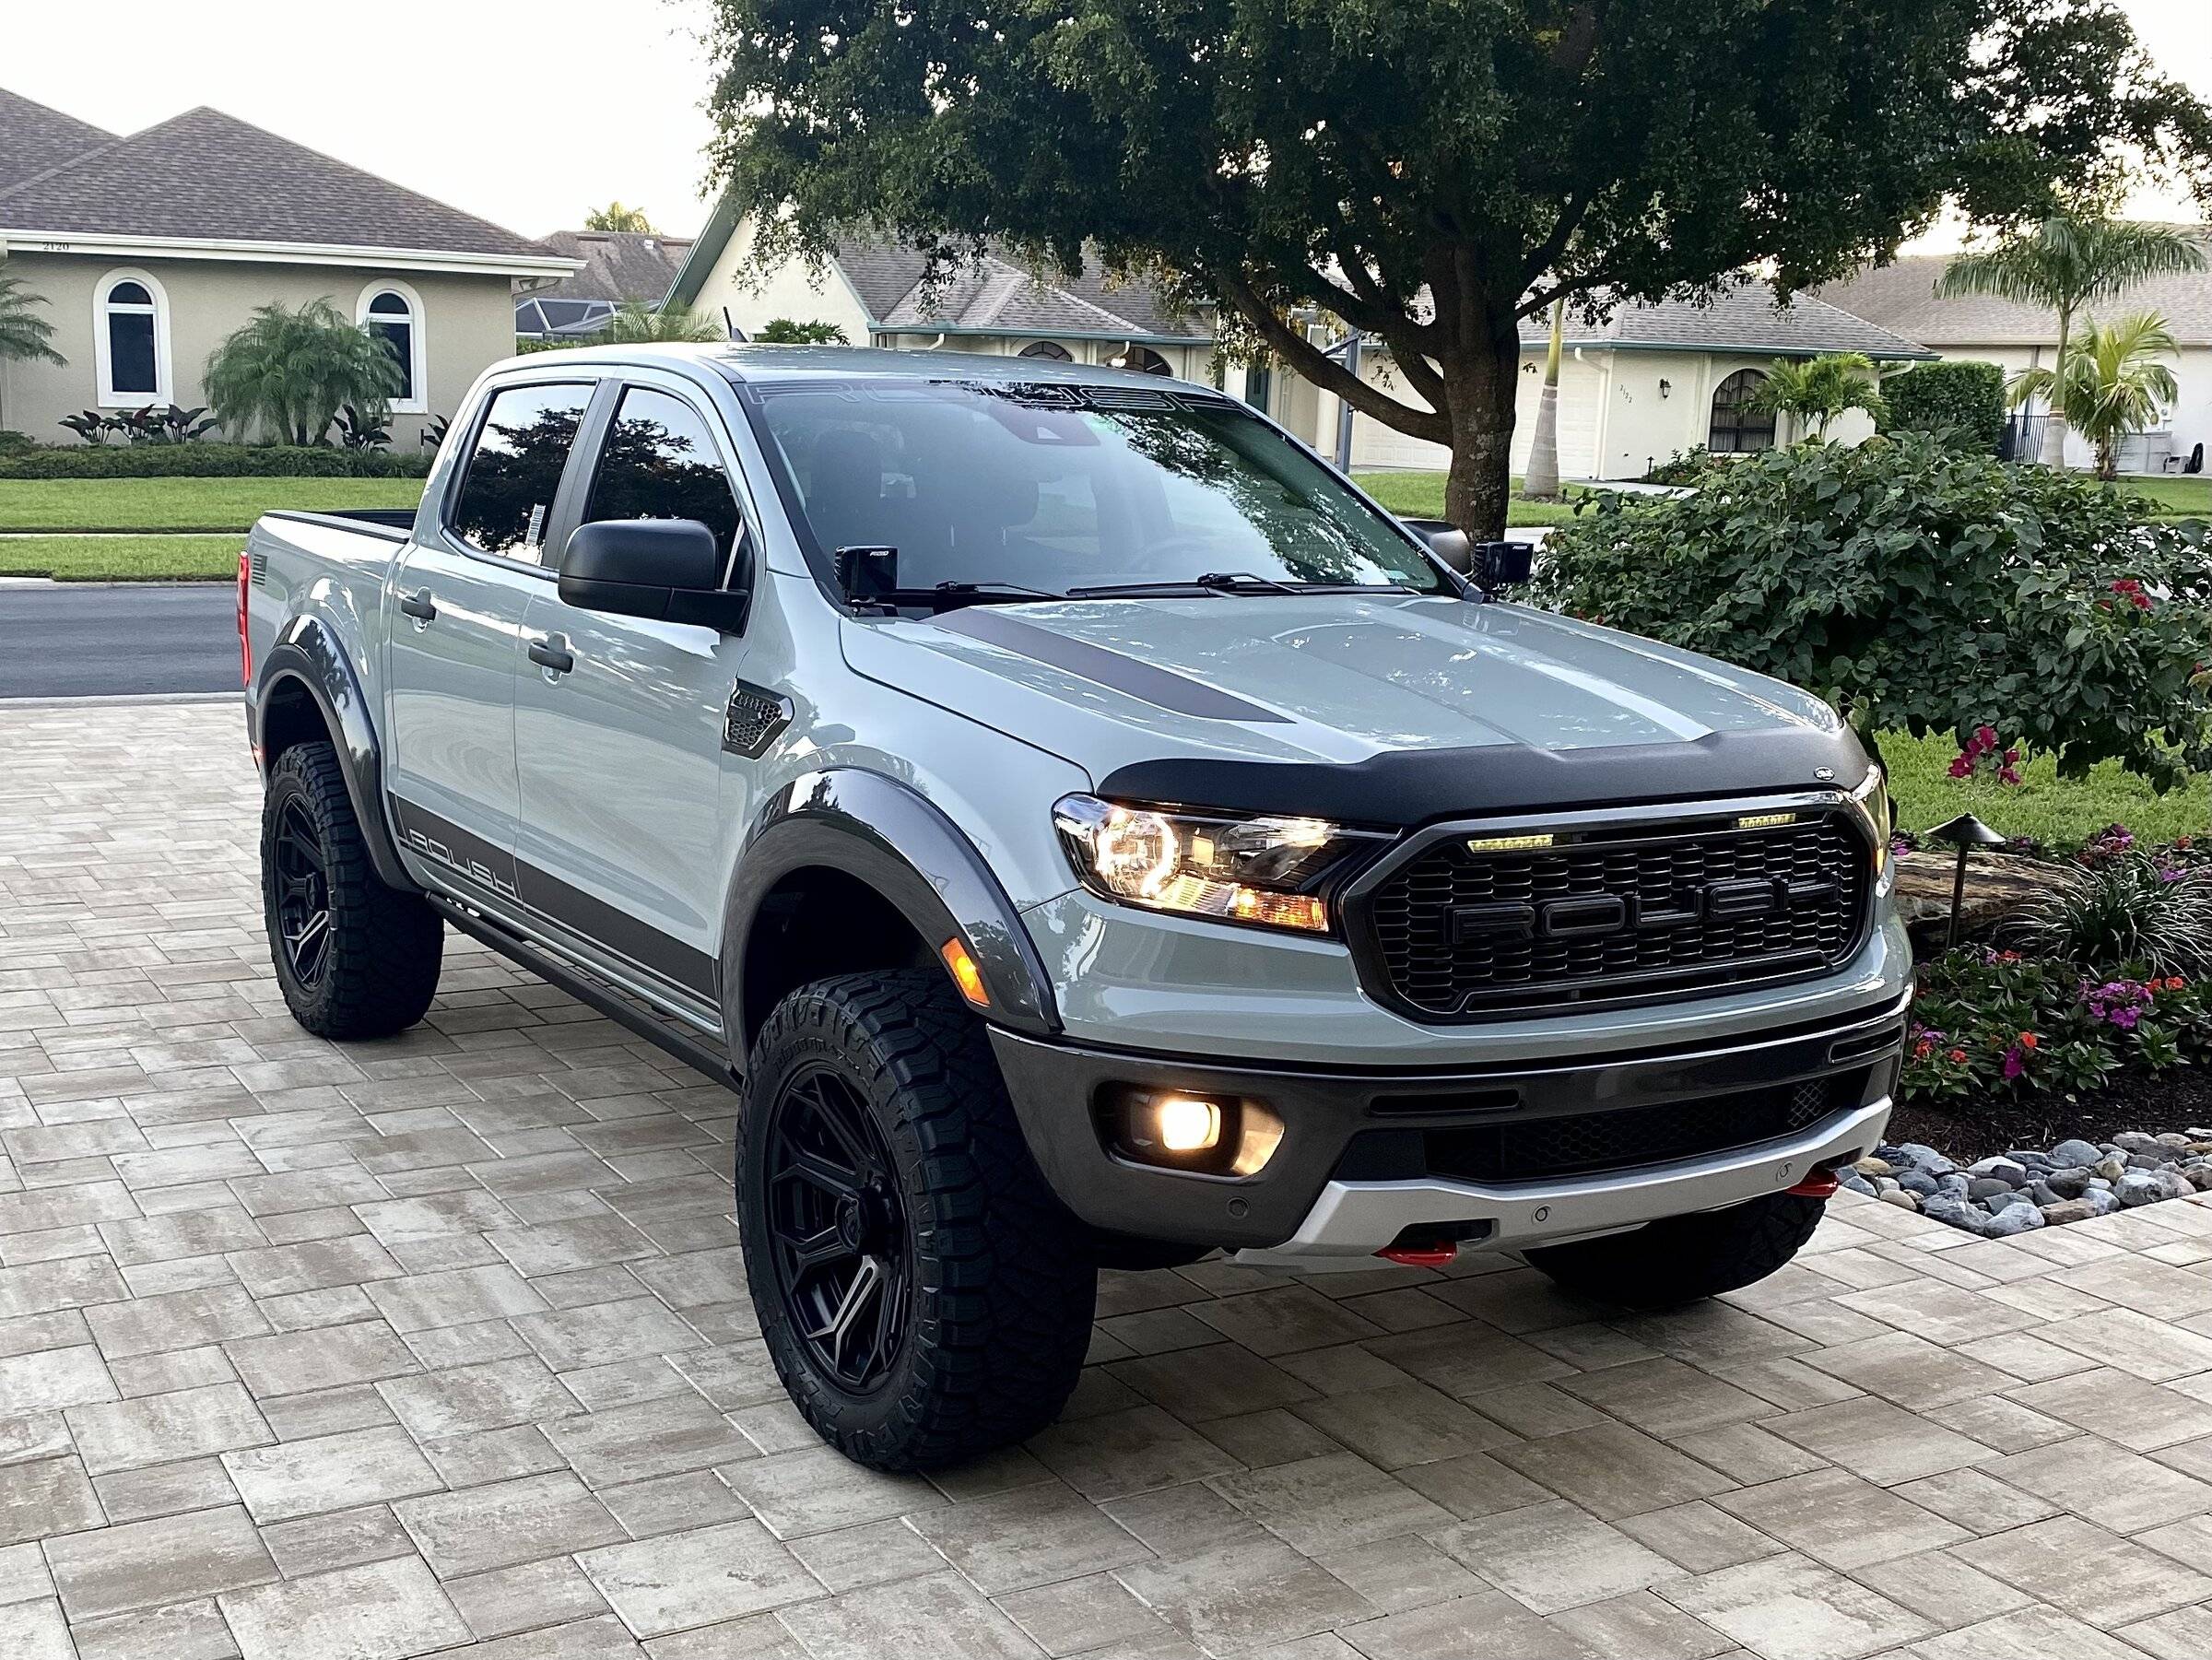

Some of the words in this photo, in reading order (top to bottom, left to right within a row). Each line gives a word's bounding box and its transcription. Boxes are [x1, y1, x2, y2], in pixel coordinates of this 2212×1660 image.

[42, 241, 70, 251] 2120
[744, 379, 1257, 418] ROUSH
[409, 829, 518, 900] ROUSH
[1443, 867, 1841, 945] ROUSH
